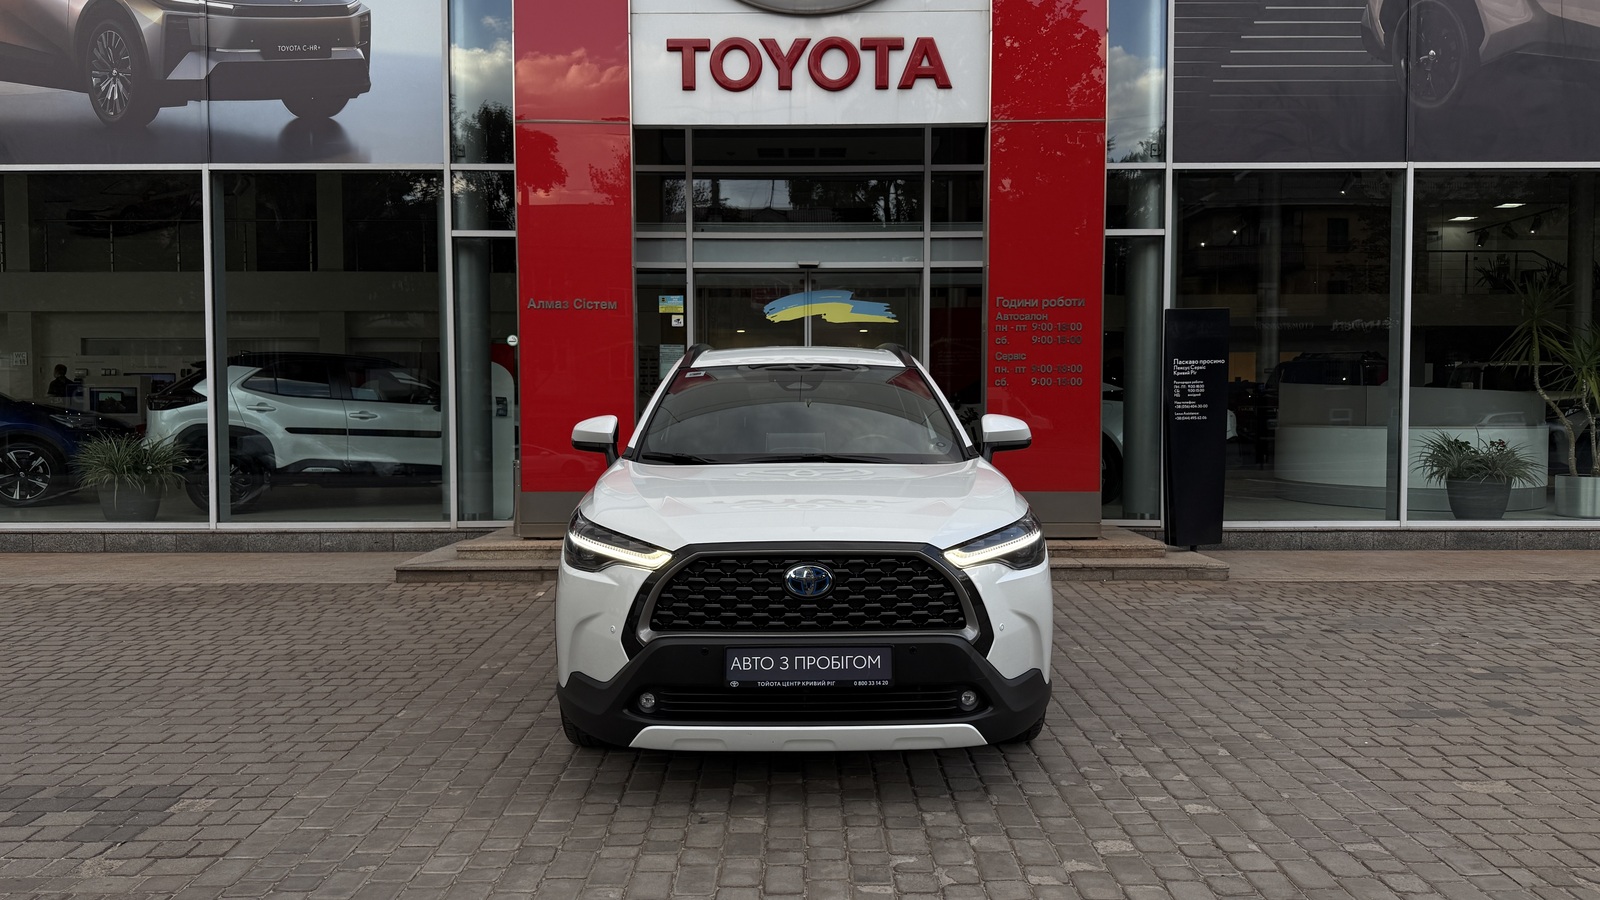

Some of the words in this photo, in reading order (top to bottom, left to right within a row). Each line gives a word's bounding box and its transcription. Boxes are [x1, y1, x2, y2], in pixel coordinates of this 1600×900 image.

[666, 36, 953, 92] TOYOTA
[527, 298, 569, 310] Алмаз
[573, 298, 618, 310] Сістем
[996, 296, 1039, 309] Години
[1042, 296, 1086, 310] роботи
[996, 312, 1048, 320] Автосалон
[995, 336, 1010, 344] сб.
[995, 352, 1027, 362] Сервіс
[994, 378, 1010, 386] сб.
[730, 656, 774, 671] АВТО
[779, 656, 790, 670] З
[794, 655, 881, 670] ПРОБІГОМ
